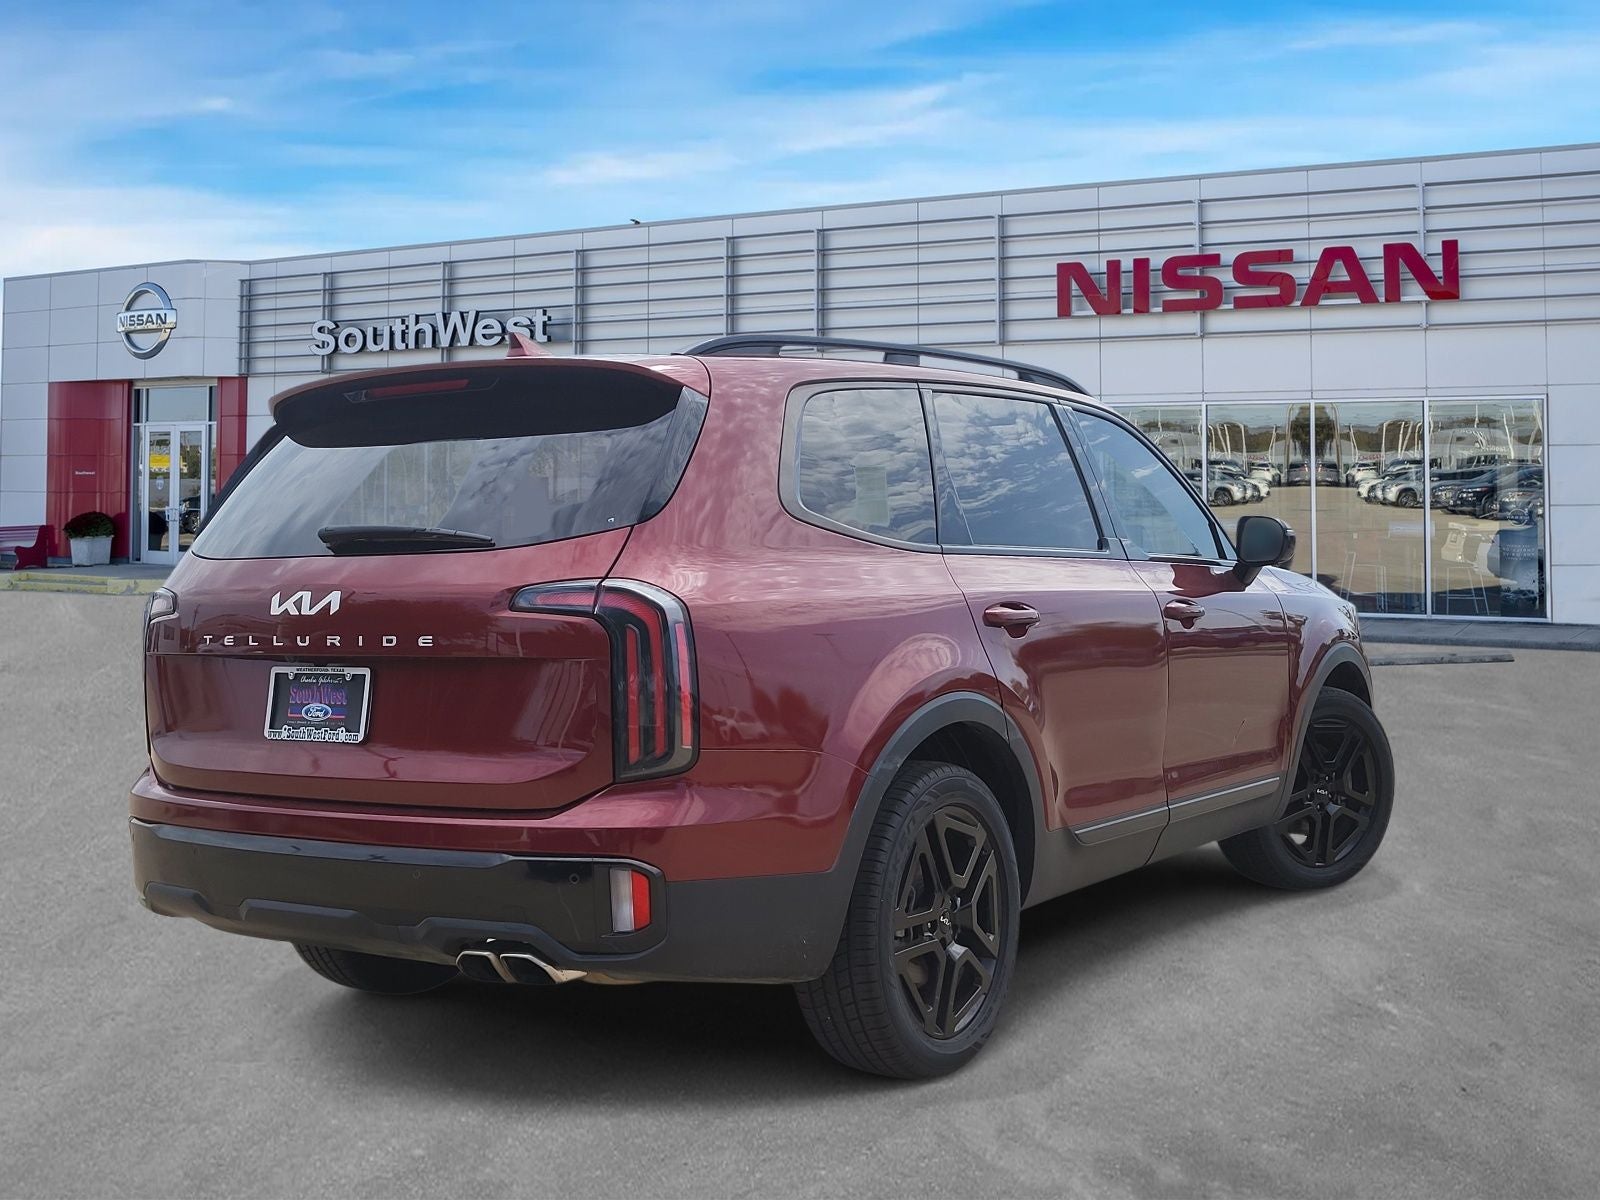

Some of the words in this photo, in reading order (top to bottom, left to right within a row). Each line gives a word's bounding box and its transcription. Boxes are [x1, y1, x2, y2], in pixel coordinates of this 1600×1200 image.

[1056, 239, 1460, 318] NISSAN
[119, 313, 167, 328] NISSAN
[308, 308, 550, 356] SouthWest
[270, 590, 342, 616] KIA
[203, 635, 434, 647] TELLURIDE
[289, 685, 347, 705] SouthWest
[308, 707, 325, 717] Ford
